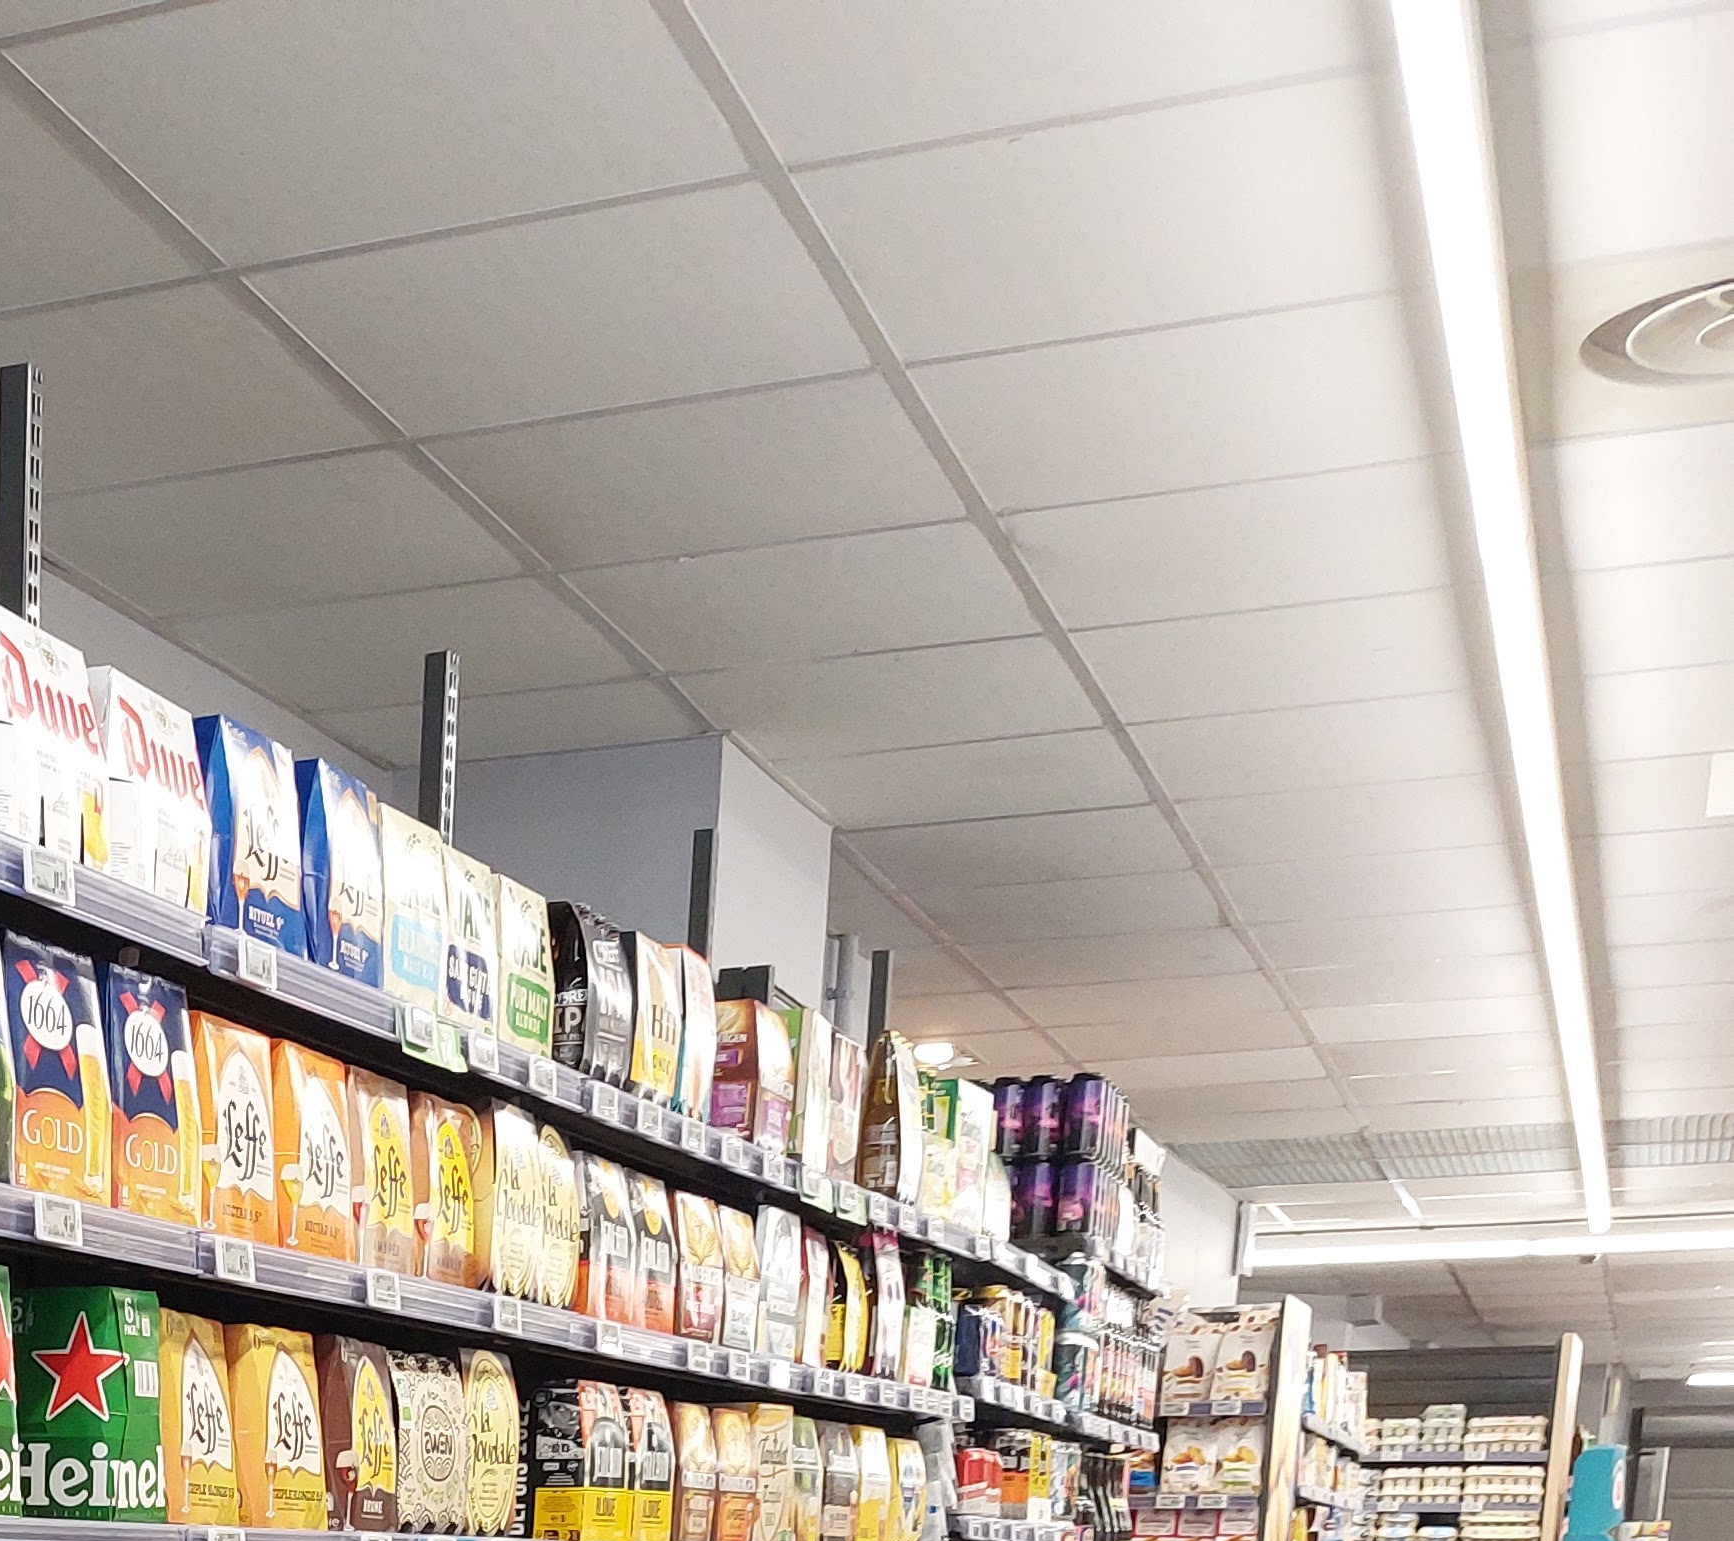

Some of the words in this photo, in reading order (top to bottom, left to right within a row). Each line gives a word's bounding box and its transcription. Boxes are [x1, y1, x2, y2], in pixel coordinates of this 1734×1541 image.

[119, 694, 206, 811] Duve
[27, 998, 69, 1036] 1664
[130, 1022, 165, 1062] 1664
[22, 1107, 84, 1155] GOLD
[125, 1134, 178, 1176] GOLD
